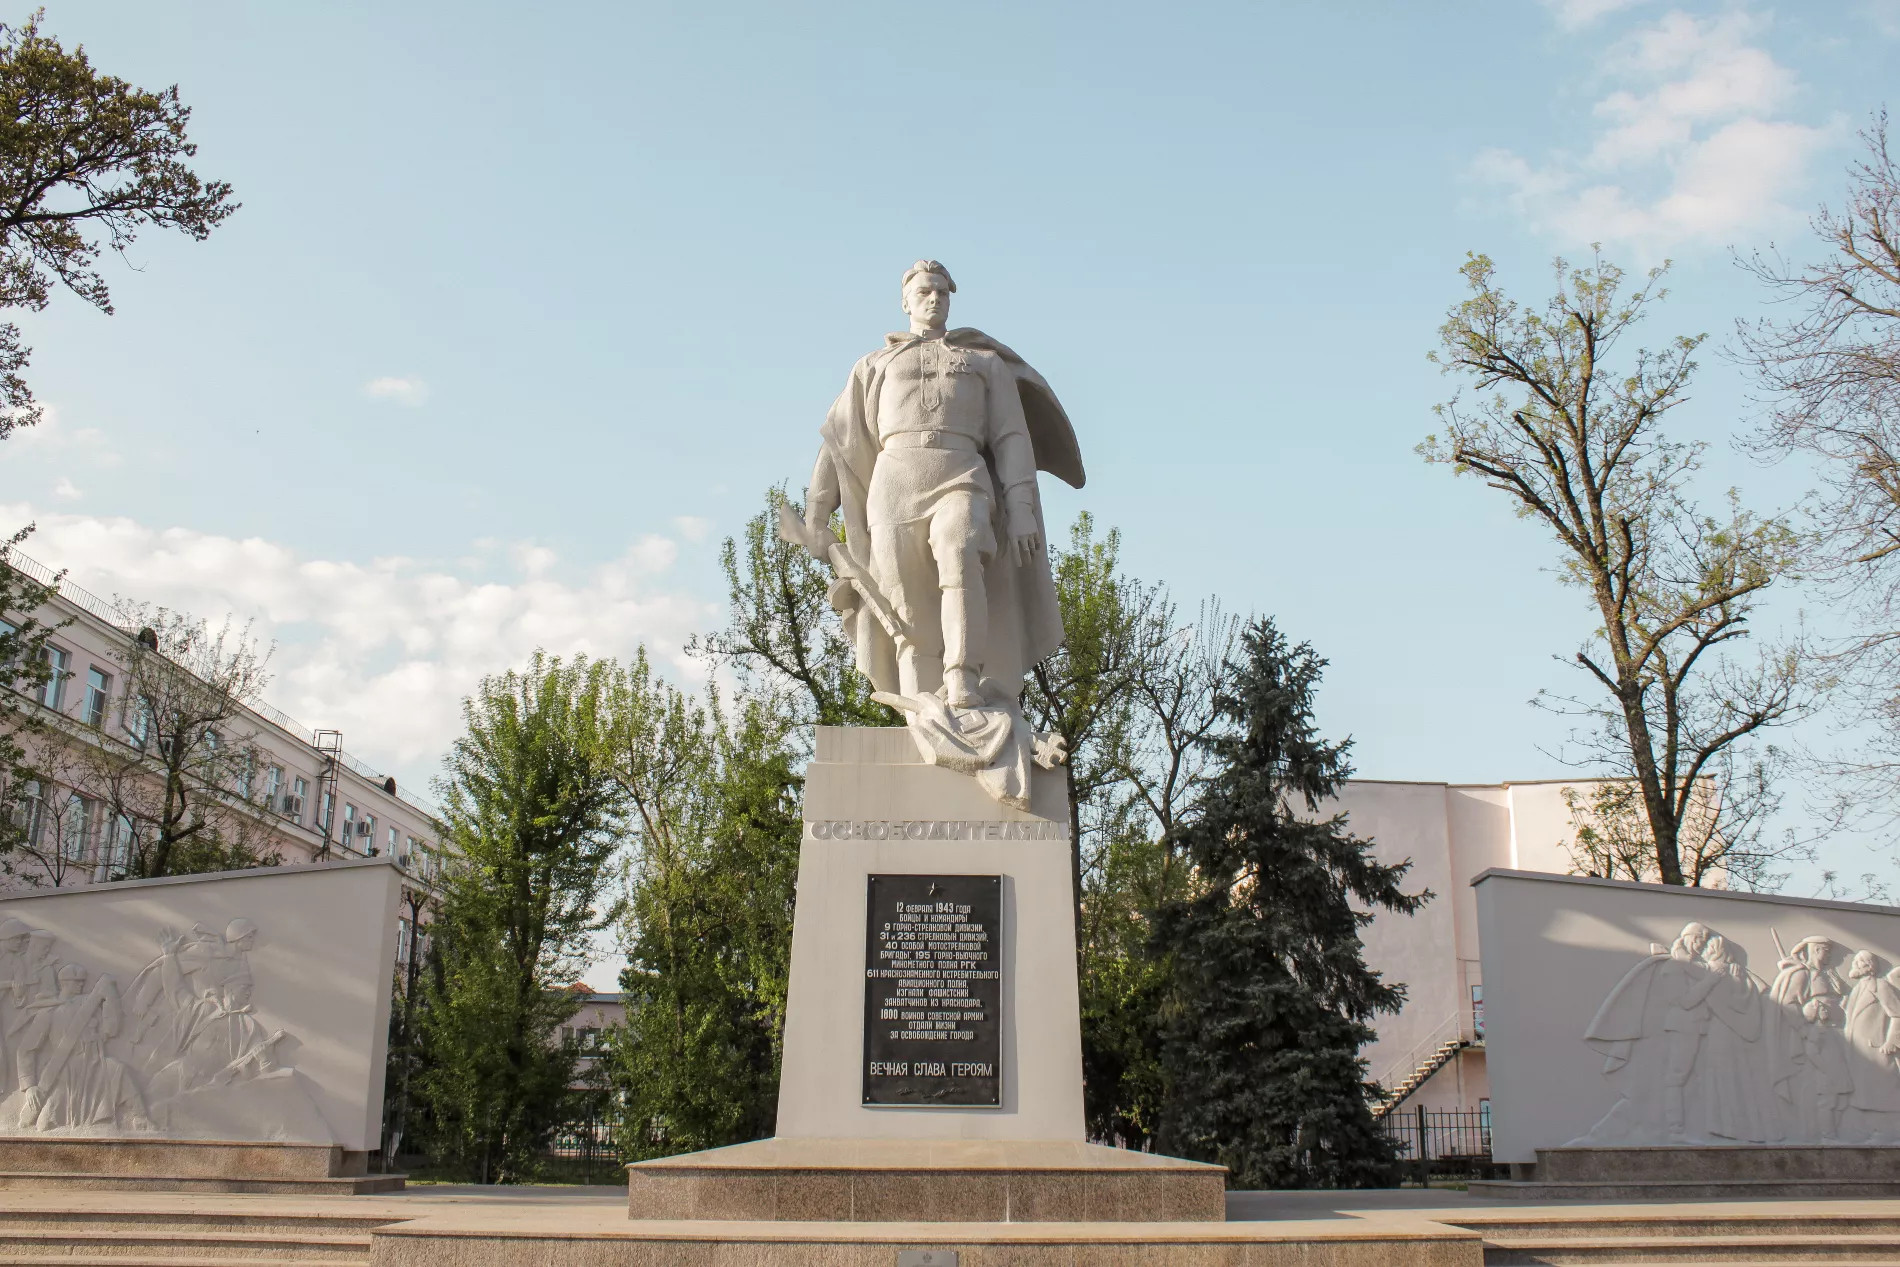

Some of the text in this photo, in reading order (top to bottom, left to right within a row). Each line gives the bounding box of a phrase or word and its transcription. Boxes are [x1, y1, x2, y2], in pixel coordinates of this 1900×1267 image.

[810, 821, 1064, 841] ОСВОБОДИТЕЛЯМ
[896, 902, 971, 913] 12 ФЕВРАЛЯ 1943 ГОДА
[900, 914, 921, 923] БОЙЦЫ
[885, 923, 890, 931] 9
[880, 932, 889, 940] 31
[885, 942, 897, 950] 40
[902, 941, 924, 950] ОСОБОЙ
[934, 952, 987, 960] ГОРНО-ВЬЮЧНОГО
[892, 960, 934, 968] МИНОМЕТНОГО
[961, 961, 976, 969] РГК
[867, 969, 878, 977] 611
[943, 971, 998, 979] ИСТРЕБИТЕЛЬНОГО
[899, 980, 944, 989] АВИАЦИОННОГО
[881, 1009, 898, 1019] 1800
[901, 1012, 924, 1020] ВОИНОВ
[909, 1021, 955, 1030] ОТДАЛИ ЖИЗНИ
[890, 1031, 974, 1040] ЗА ОСВОБОЖДЕНИЕ ГОРОДА
[870, 1062, 992, 1076] ВЕЧНАЯ СЛАВА ГЕРОЯМ
